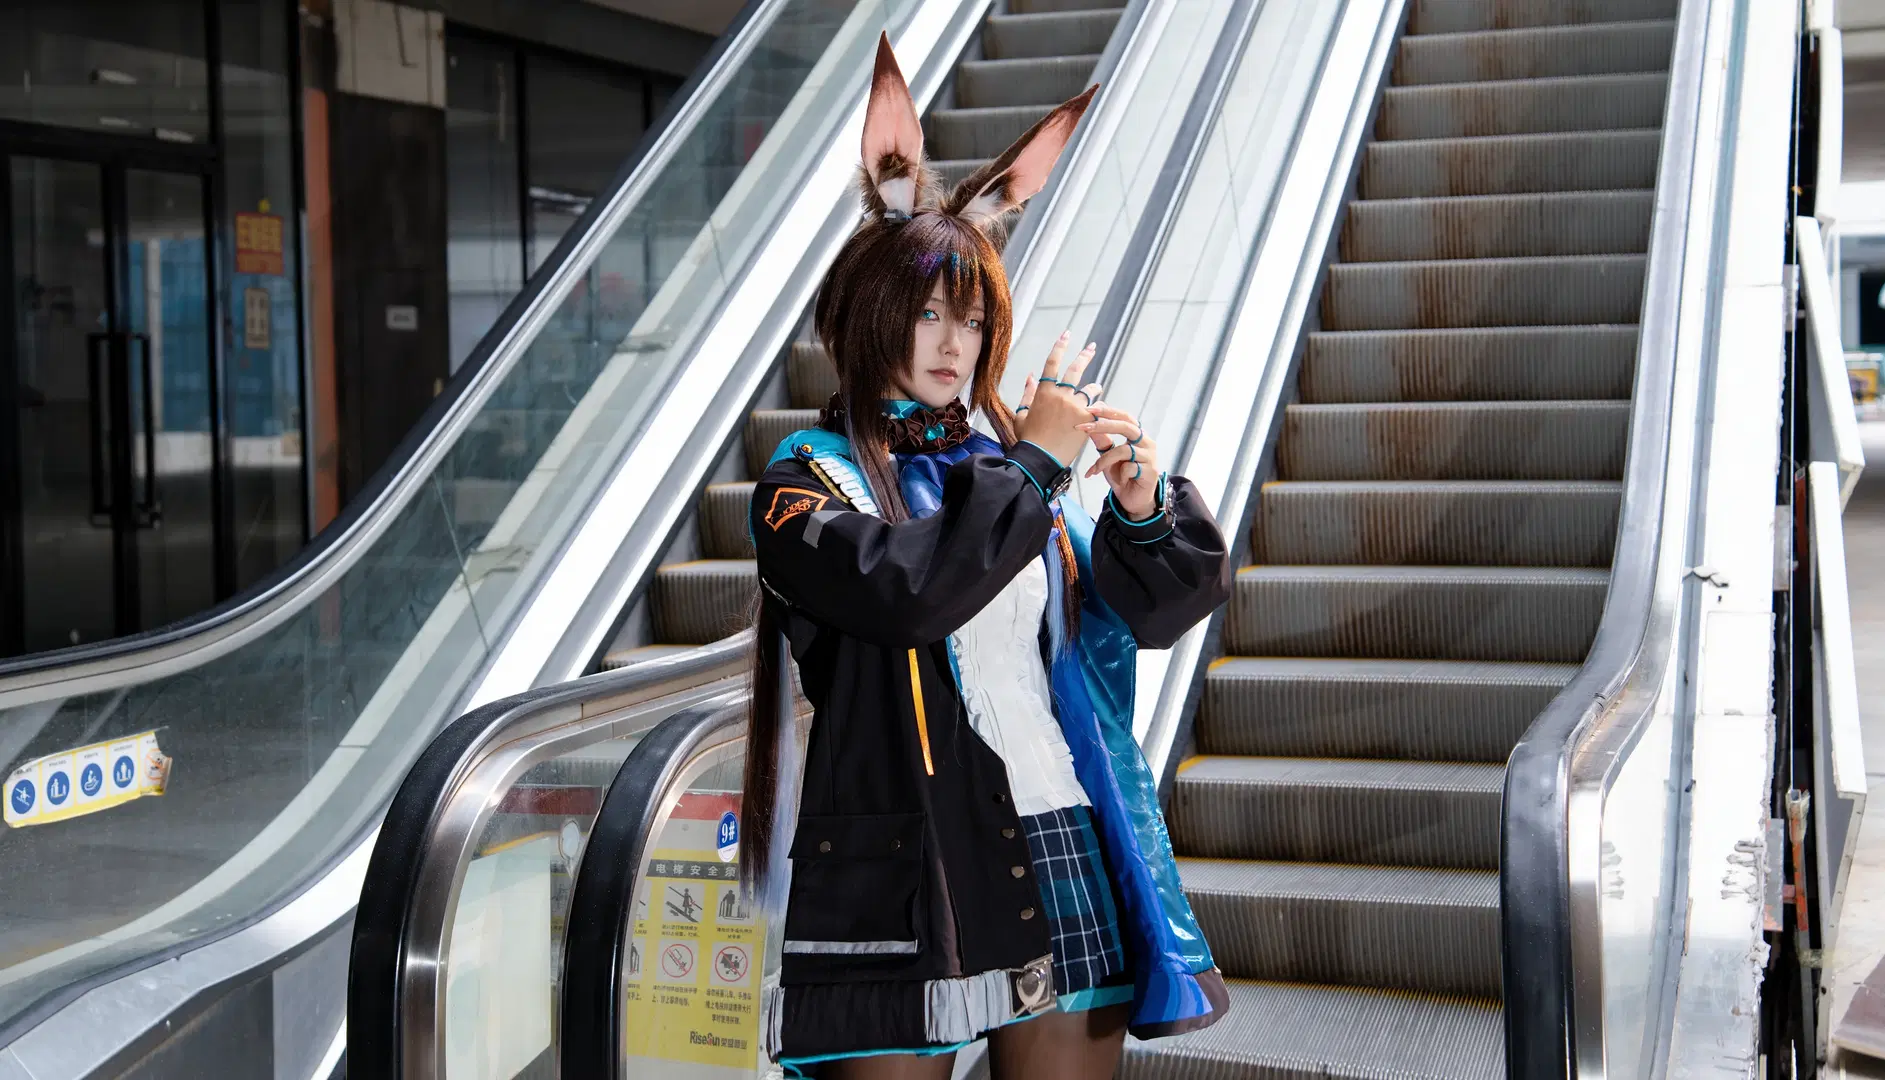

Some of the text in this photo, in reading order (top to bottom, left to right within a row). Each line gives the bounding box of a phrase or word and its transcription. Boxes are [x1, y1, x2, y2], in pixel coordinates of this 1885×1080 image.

[721, 821, 735, 843] 9#
[655, 863, 737, 877] 电梯安全须
[690, 1031, 720, 1047] RiseSun
